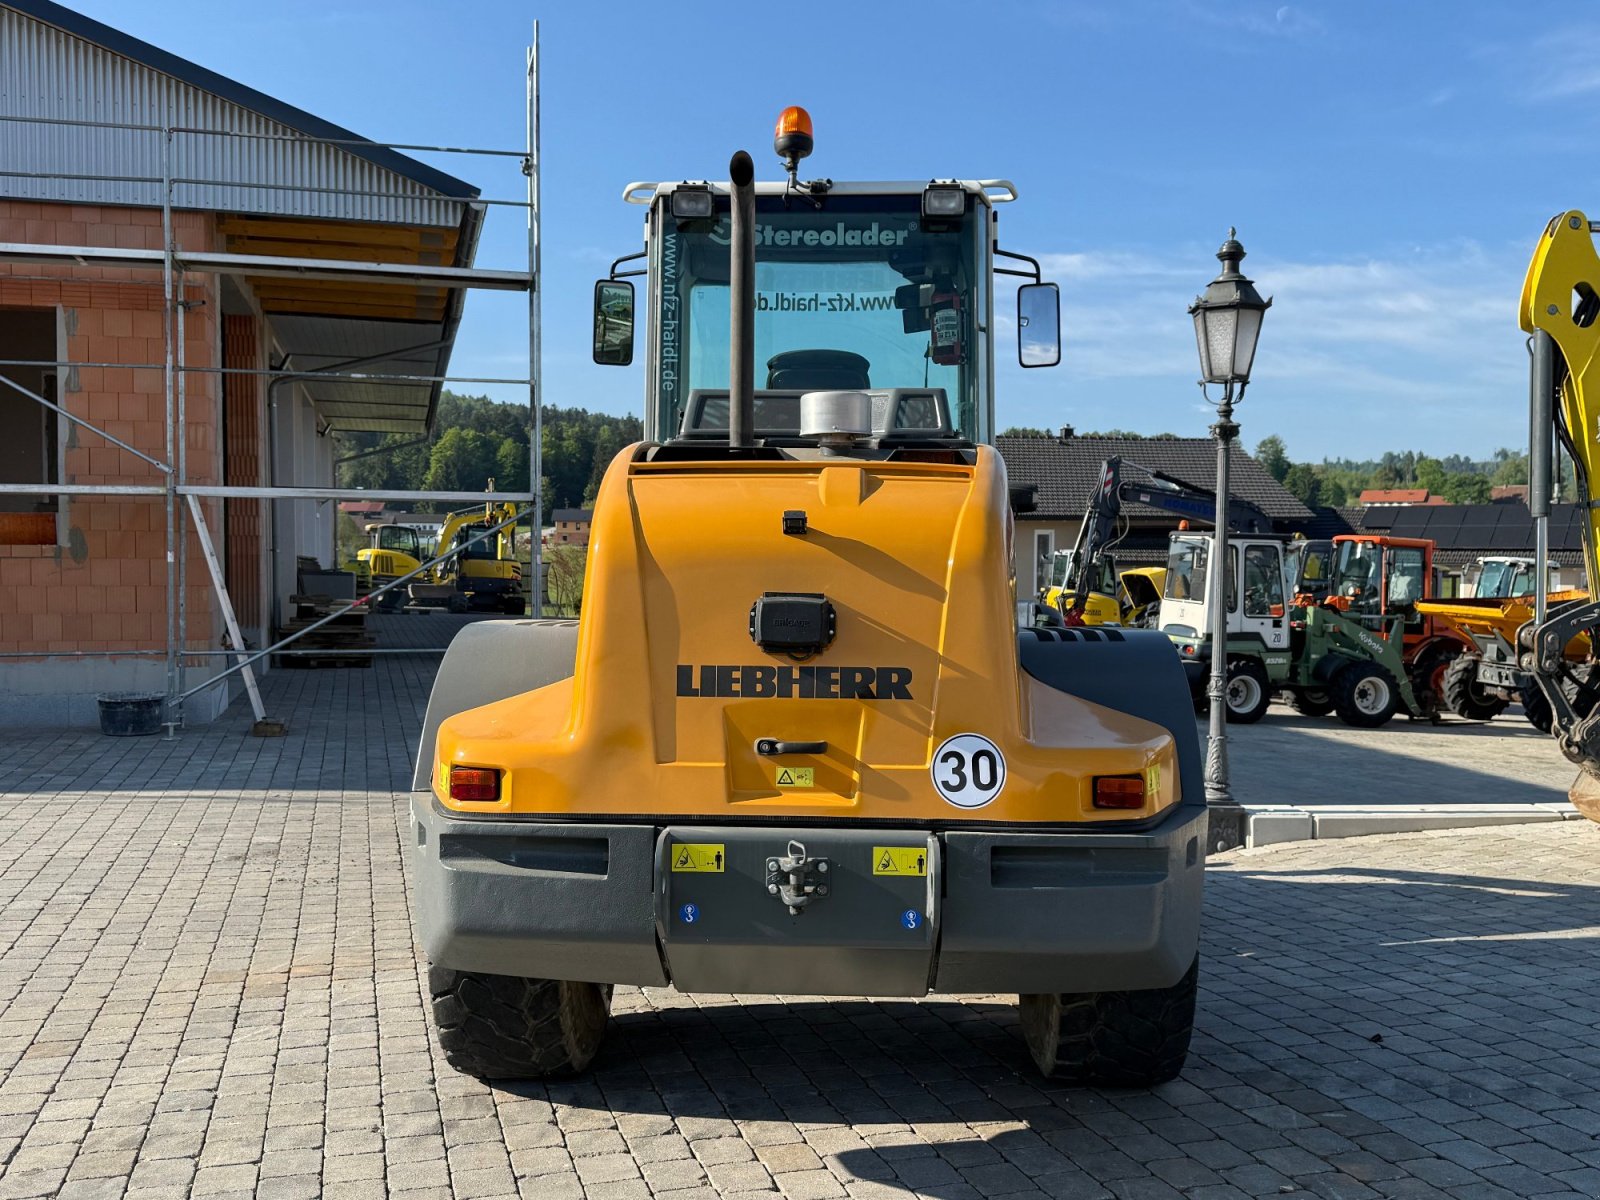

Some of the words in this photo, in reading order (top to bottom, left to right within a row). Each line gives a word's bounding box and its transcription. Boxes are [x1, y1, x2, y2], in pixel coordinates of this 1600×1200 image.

[663, 233, 679, 391] www.nfz-haidl.de
[1273, 633, 1282, 643] 20
[677, 665, 913, 699] LIEBHERR
[940, 749, 997, 792] 30
